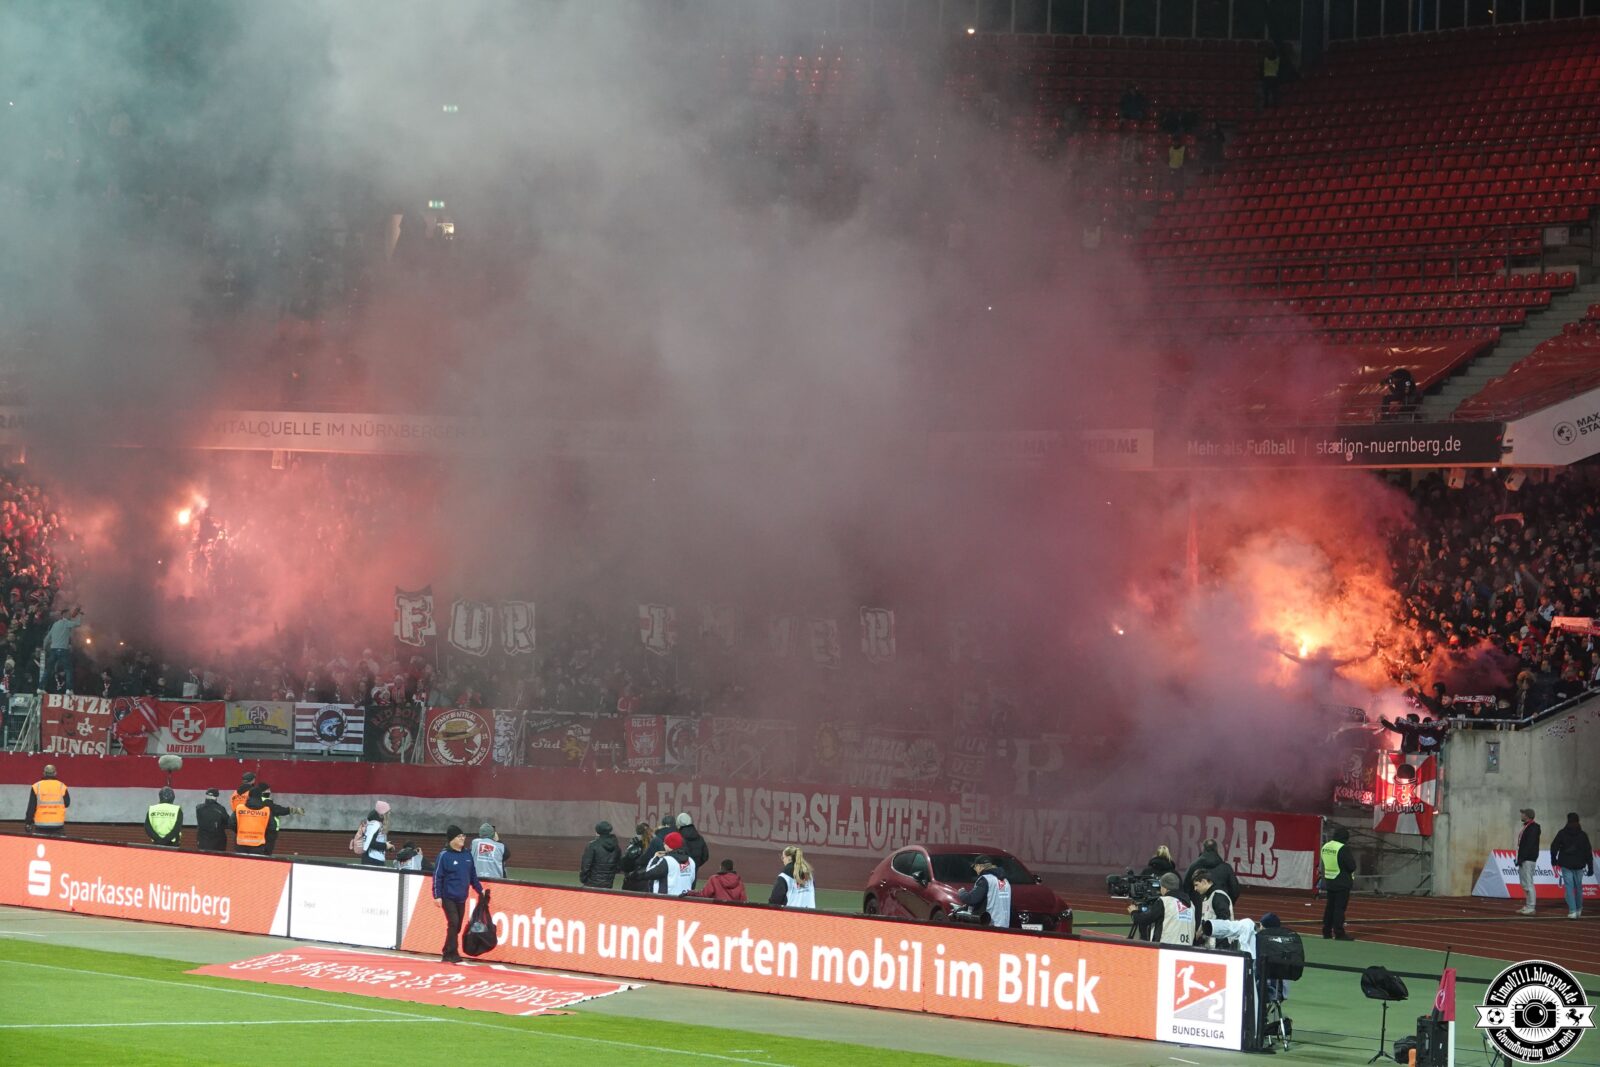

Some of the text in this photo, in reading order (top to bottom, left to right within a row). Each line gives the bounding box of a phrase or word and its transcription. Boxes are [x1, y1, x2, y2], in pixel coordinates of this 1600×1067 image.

[326, 422, 346, 437] IM
[1186, 439, 1219, 455] Mehr
[1246, 438, 1297, 455] Fußball
[1315, 435, 1462, 456] stadion-nuernberg.de
[47, 694, 112, 715] BETZE
[44, 736, 107, 755] JUNGS
[166, 743, 206, 754] LAUTERTAL
[59, 873, 144, 908] Sparkasse
[148, 882, 231, 925] Nürnberg
[597, 914, 665, 963] und
[676, 918, 798, 979] Karten
[811, 937, 923, 994] mobil
[934, 944, 984, 1000] im
[997, 952, 1102, 1015] Blick
[1172, 1025, 1225, 1041] BUNDESLIGA
